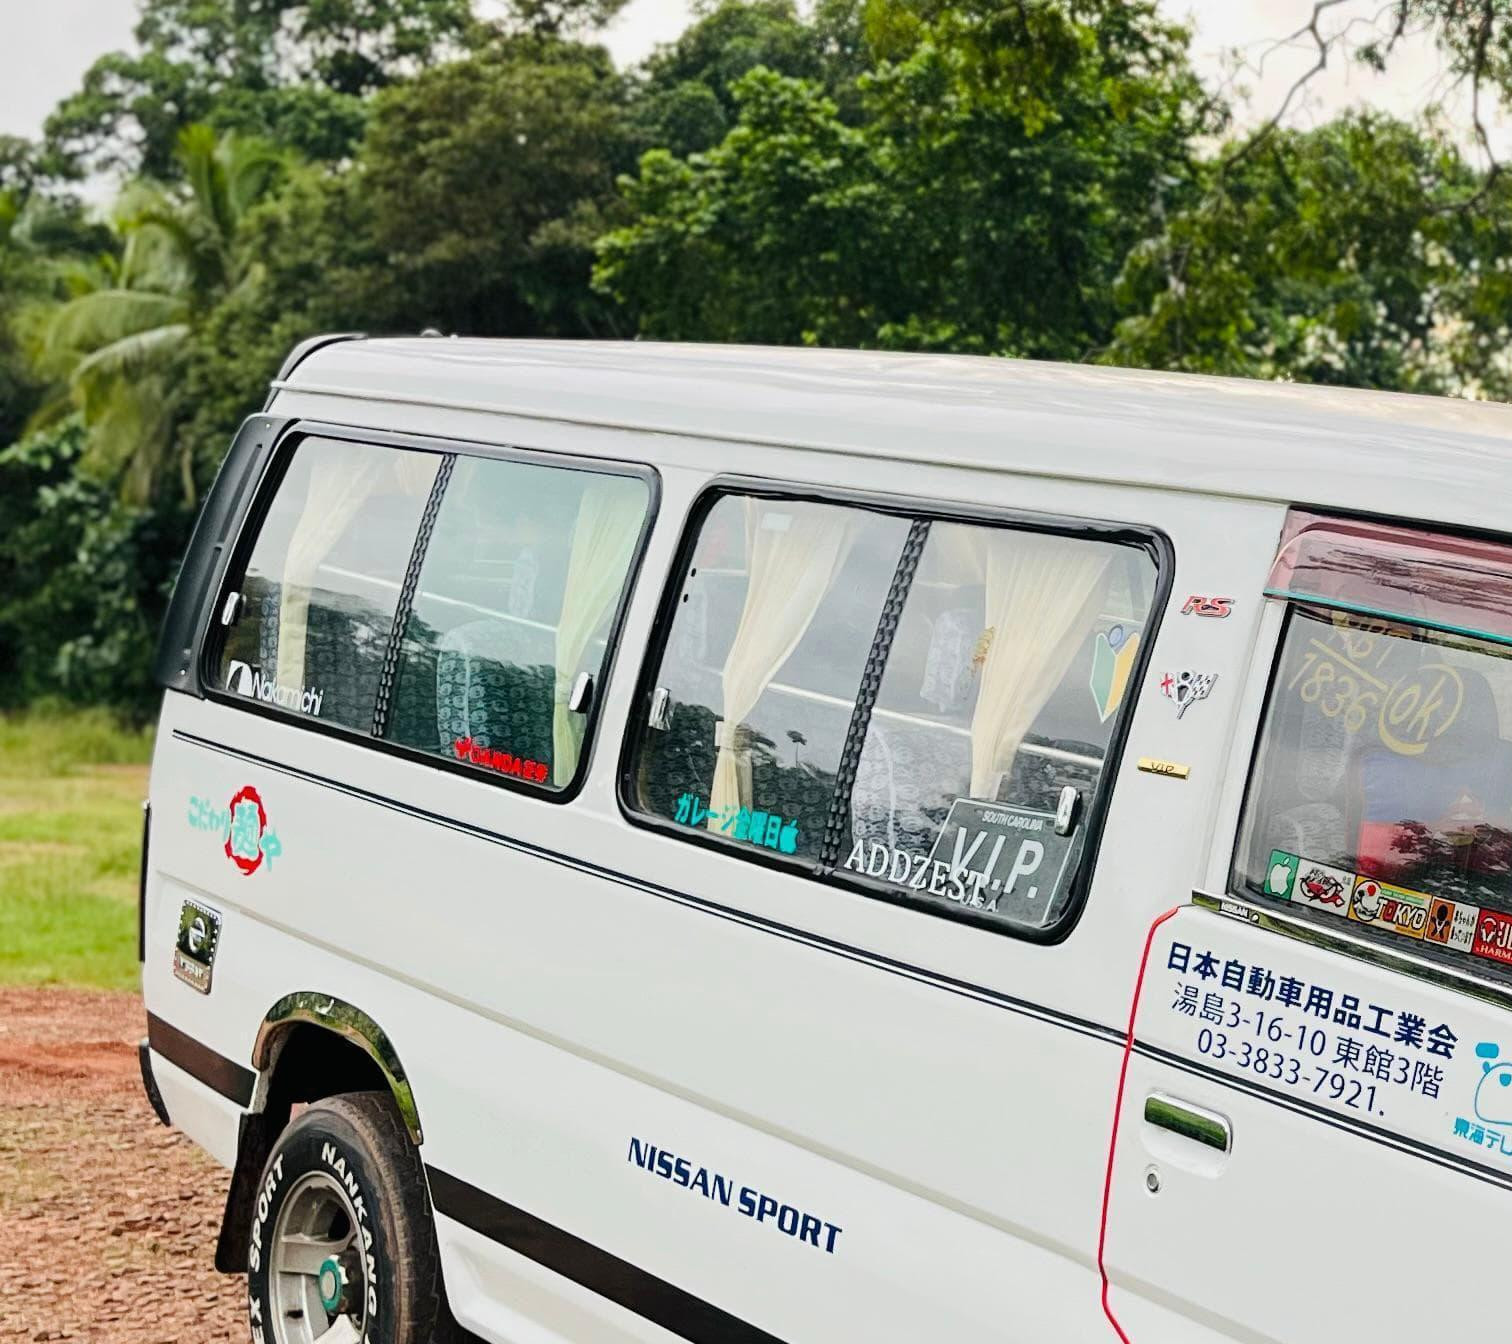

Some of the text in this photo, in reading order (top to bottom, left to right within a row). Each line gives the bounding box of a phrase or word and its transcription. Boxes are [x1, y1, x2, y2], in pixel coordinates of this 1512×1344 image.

[1181, 596, 1235, 618] RS
[252, 672, 324, 716] Nakamichi
[982, 809, 1044, 832] SOUTH CAROLINA
[843, 839, 990, 904] ADDZEST
[1376, 896, 1428, 931] TOKYO
[1166, 941, 1459, 1059] 日本自動車用品工業会
[1171, 981, 1445, 1100] 湯島3-16-10 東館3階
[1197, 1028, 1386, 1116] 03-3833-7921.
[249, 1154, 284, 1273] SPORT
[321, 1142, 377, 1317] NANKANG
[628, 1136, 843, 1254] NISSAN SPORT
